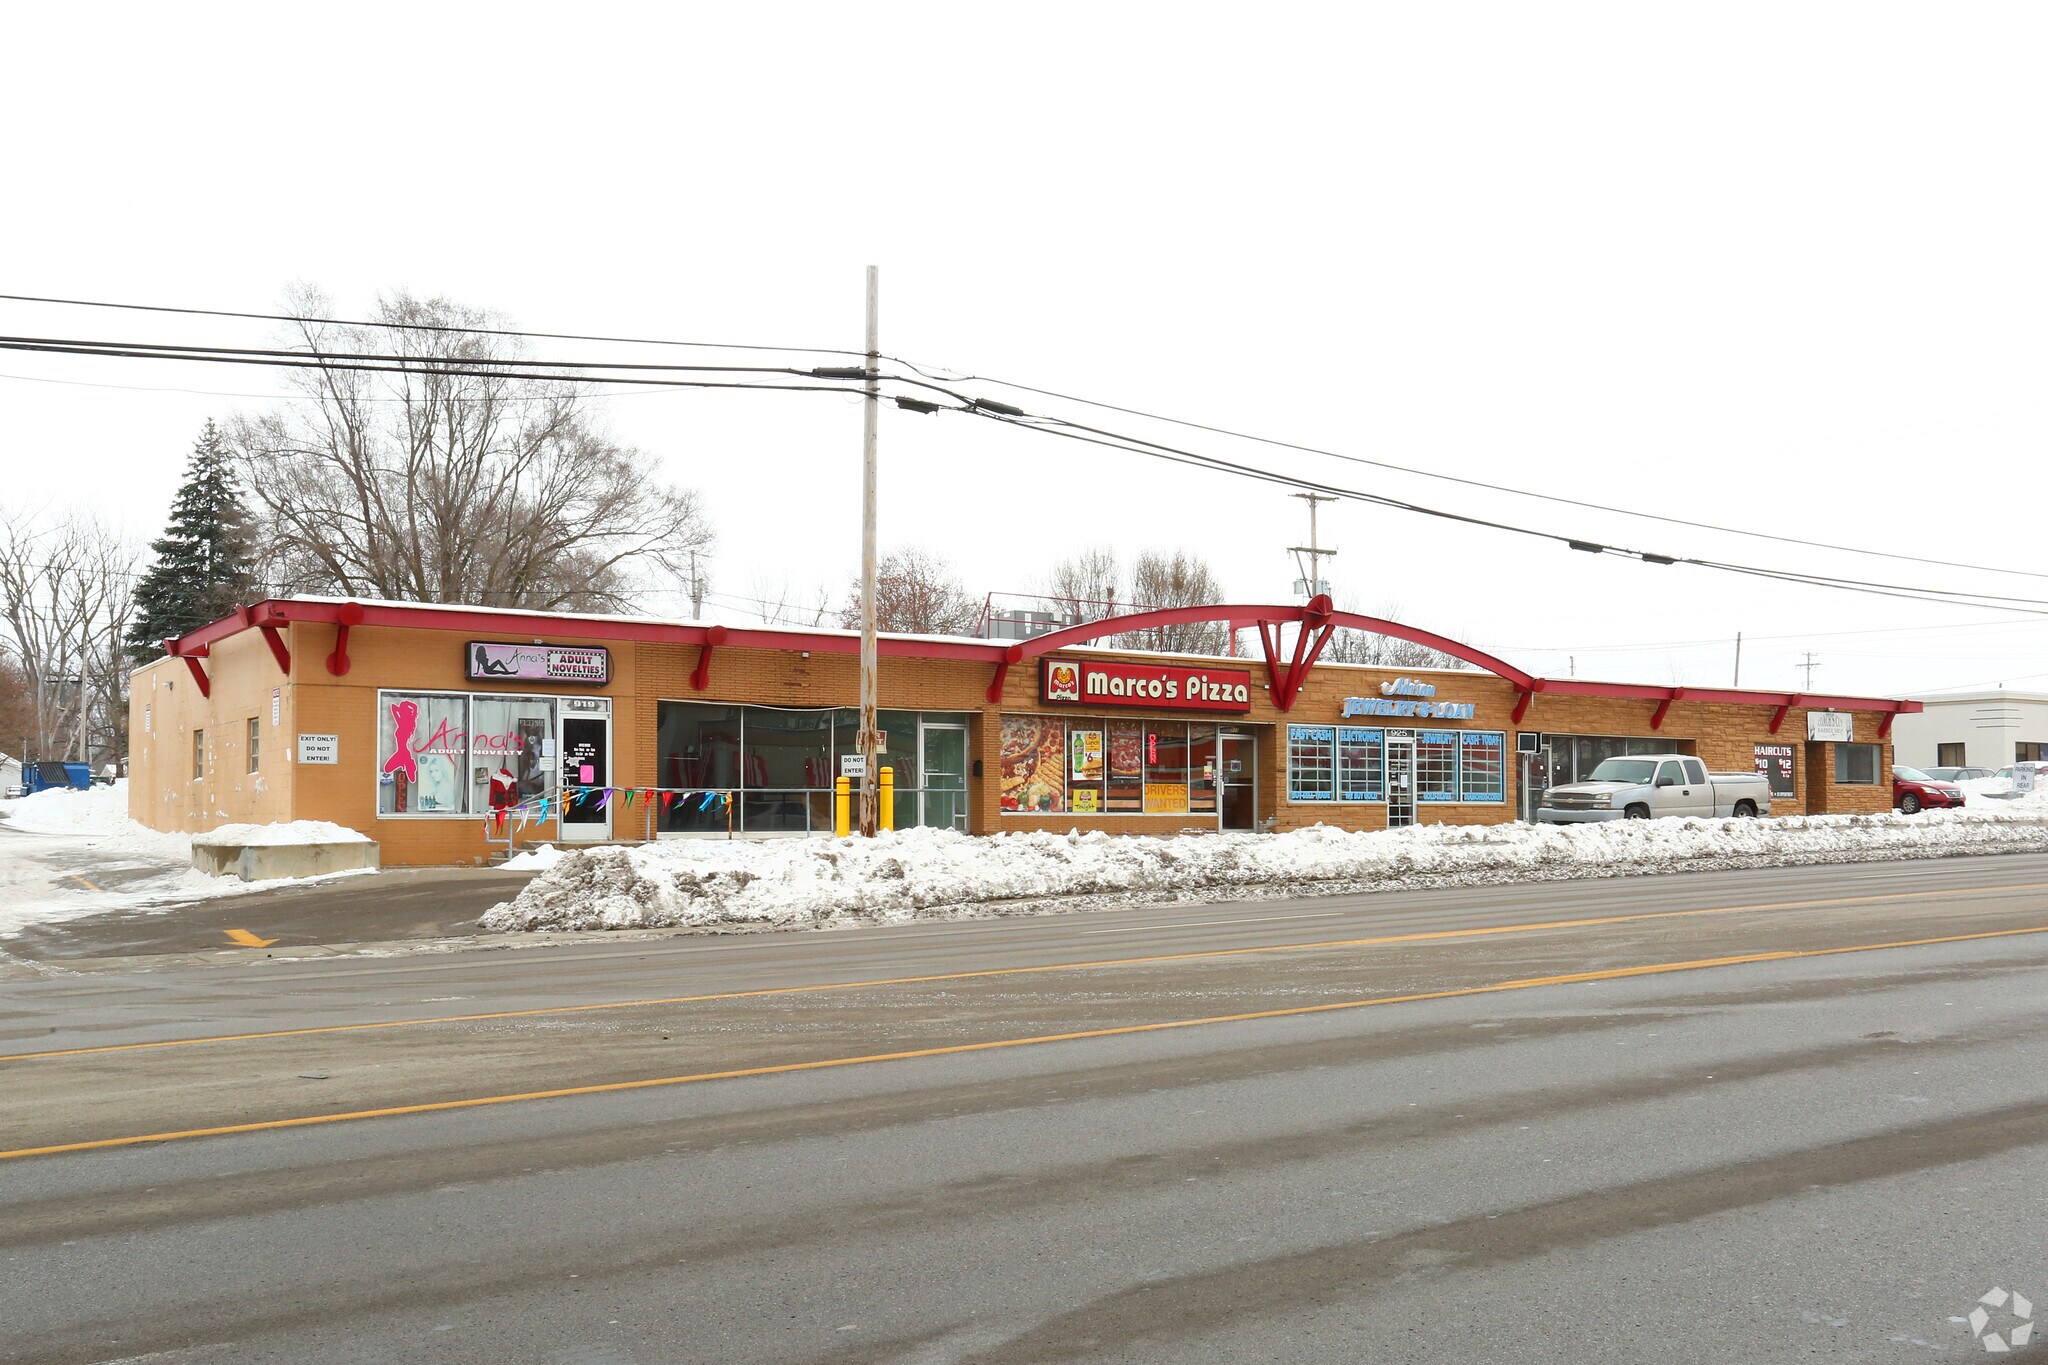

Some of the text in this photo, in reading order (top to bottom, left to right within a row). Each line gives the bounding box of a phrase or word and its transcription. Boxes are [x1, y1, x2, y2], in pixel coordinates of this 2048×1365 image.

[505, 647, 546, 671] Anna's
[560, 655, 592, 664] ADULT
[552, 664, 600, 674] NOVELTIES
[1086, 671, 1248, 703] Marco's Pizza
[1380, 677, 1436, 698] Adrian
[573, 700, 596, 708] 919
[1341, 697, 1475, 719] JEWELRY & LOAN
[1291, 728, 1332, 741] FAST CASH
[1340, 730, 1382, 743] ELECTRONICS
[1390, 729, 1408, 737] 925
[1422, 733, 1453, 745] JEWELRY
[412, 717, 526, 768] Anna's
[1462, 735, 1500, 746] CASH TODAY
[1149, 733, 1157, 764] OPEN
[1754, 746, 1792, 756] HAIRCUTS
[1755, 758, 1791, 769] $10 $12
[1144, 784, 1187, 796] DRIVERS
[1145, 797, 1187, 809] WANTED
